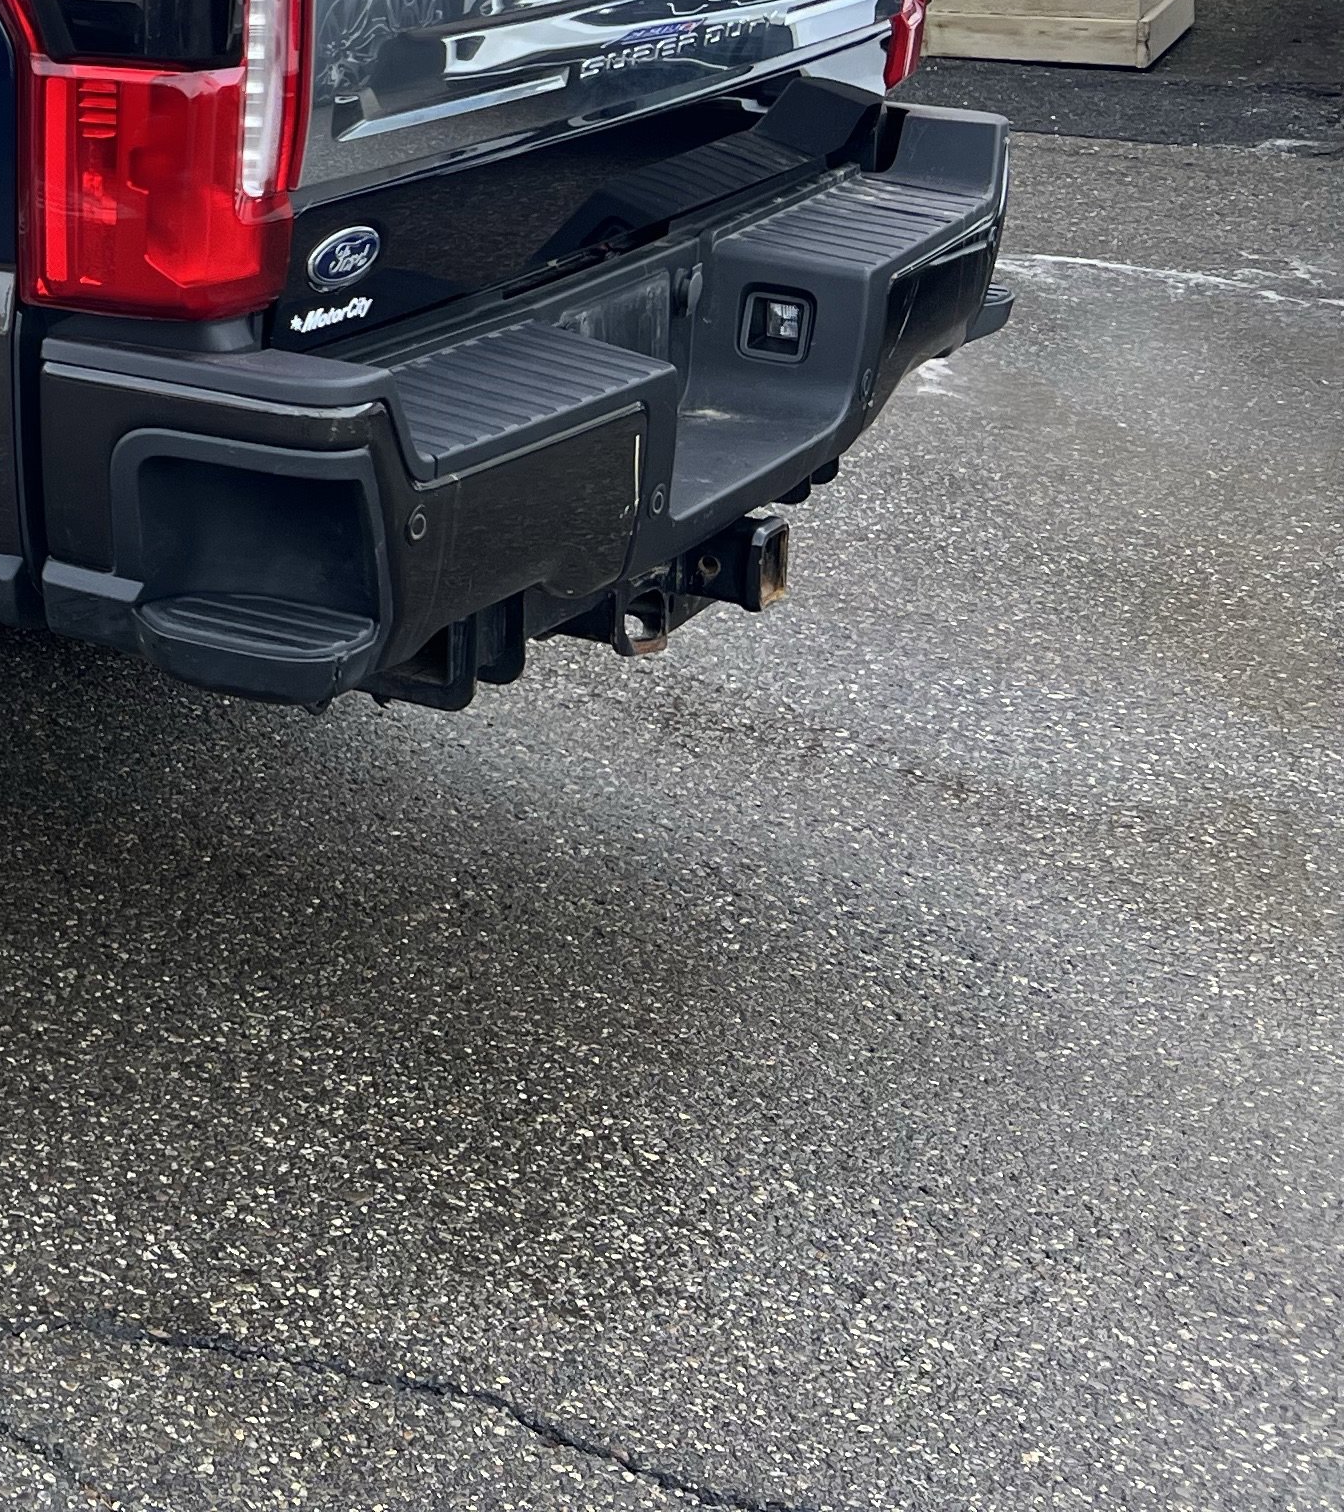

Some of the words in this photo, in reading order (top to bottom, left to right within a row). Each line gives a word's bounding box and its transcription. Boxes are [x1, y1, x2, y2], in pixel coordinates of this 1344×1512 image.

[579, 32, 699, 80] SUPER
[704, 10, 779, 46] DUTY
[327, 235, 372, 275] Ford
